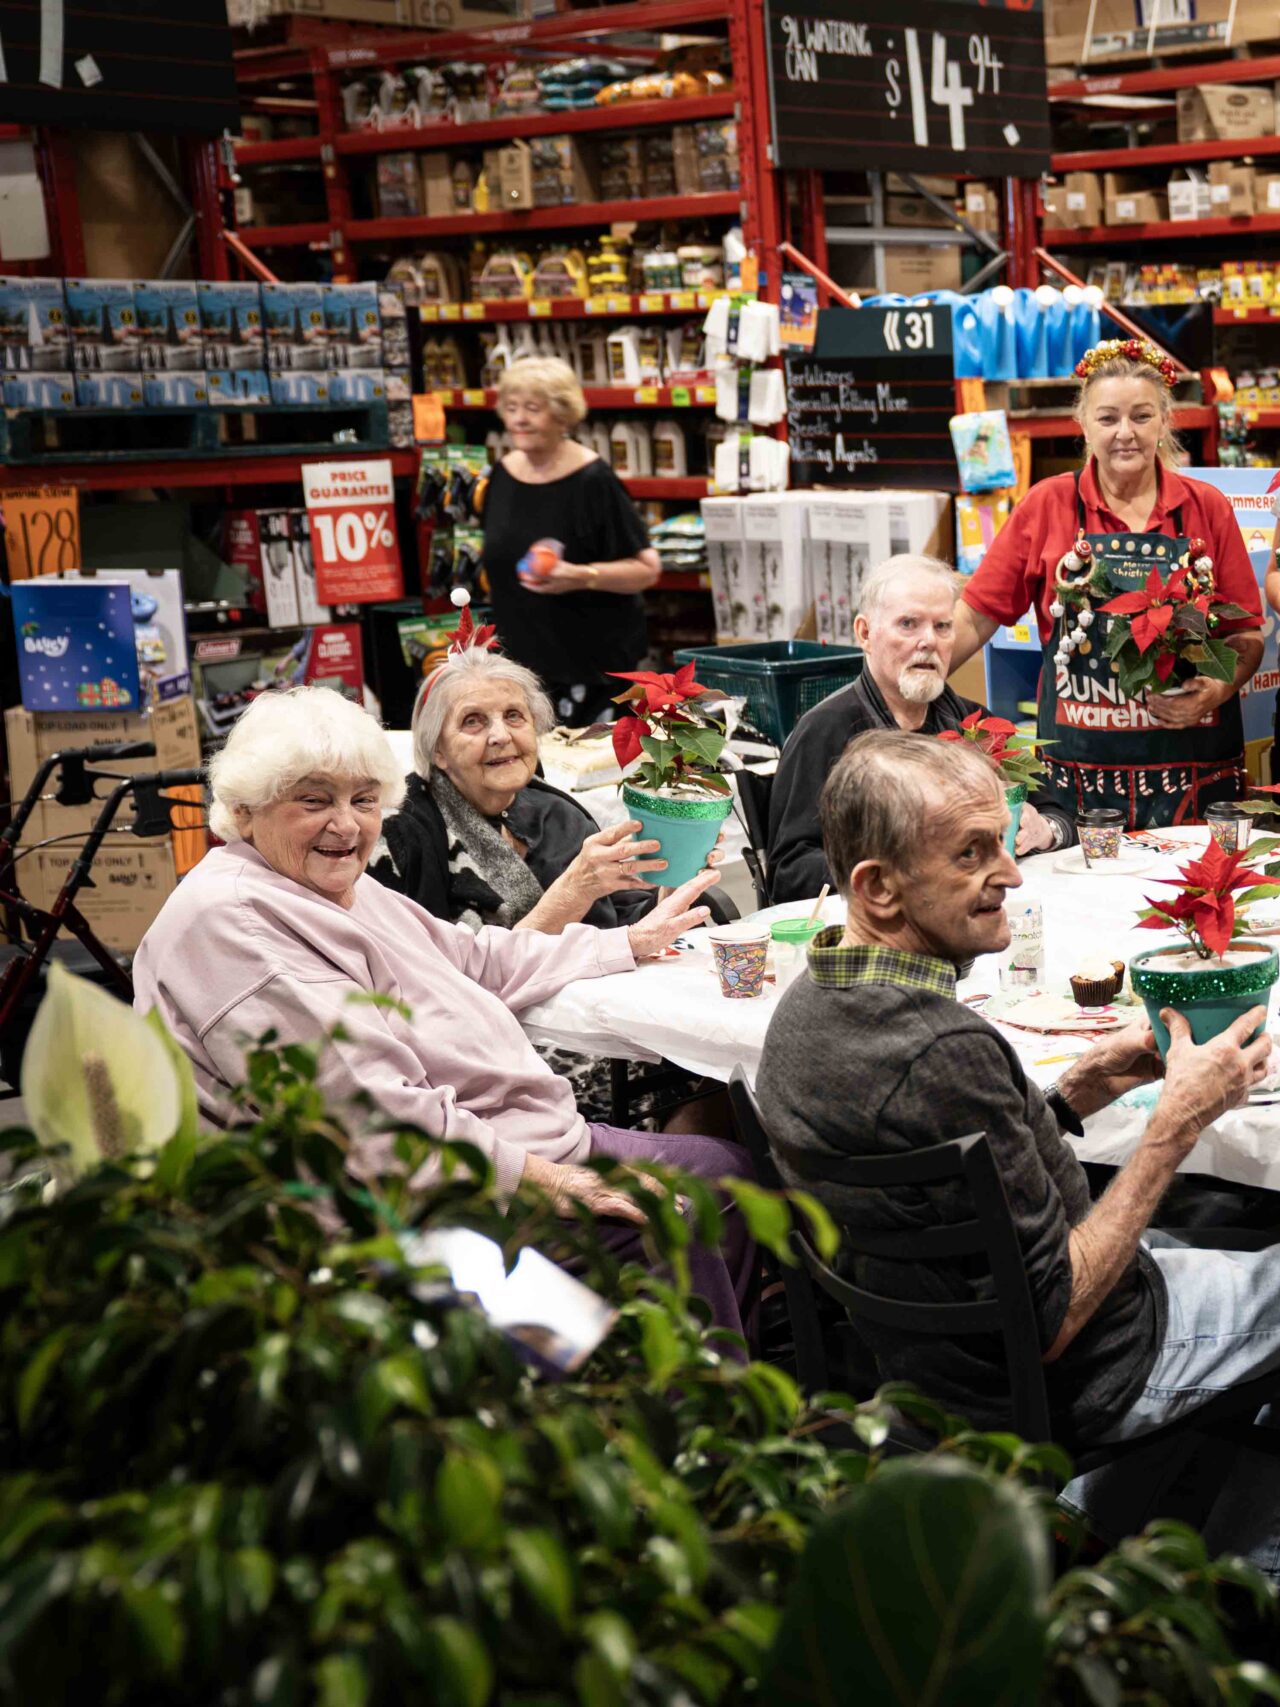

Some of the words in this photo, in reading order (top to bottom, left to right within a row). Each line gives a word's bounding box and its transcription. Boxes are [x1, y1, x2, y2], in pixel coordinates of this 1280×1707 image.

[804, 19, 872, 56] WATERING
[785, 50, 818, 82] CAN
[904, 312, 933, 349] 31
[787, 412, 830, 435] Seeds
[835, 433, 878, 472] Agents
[310, 484, 390, 499] GUARANTEE
[330, 470, 367, 482] PRICE
[313, 510, 395, 564] 10%
